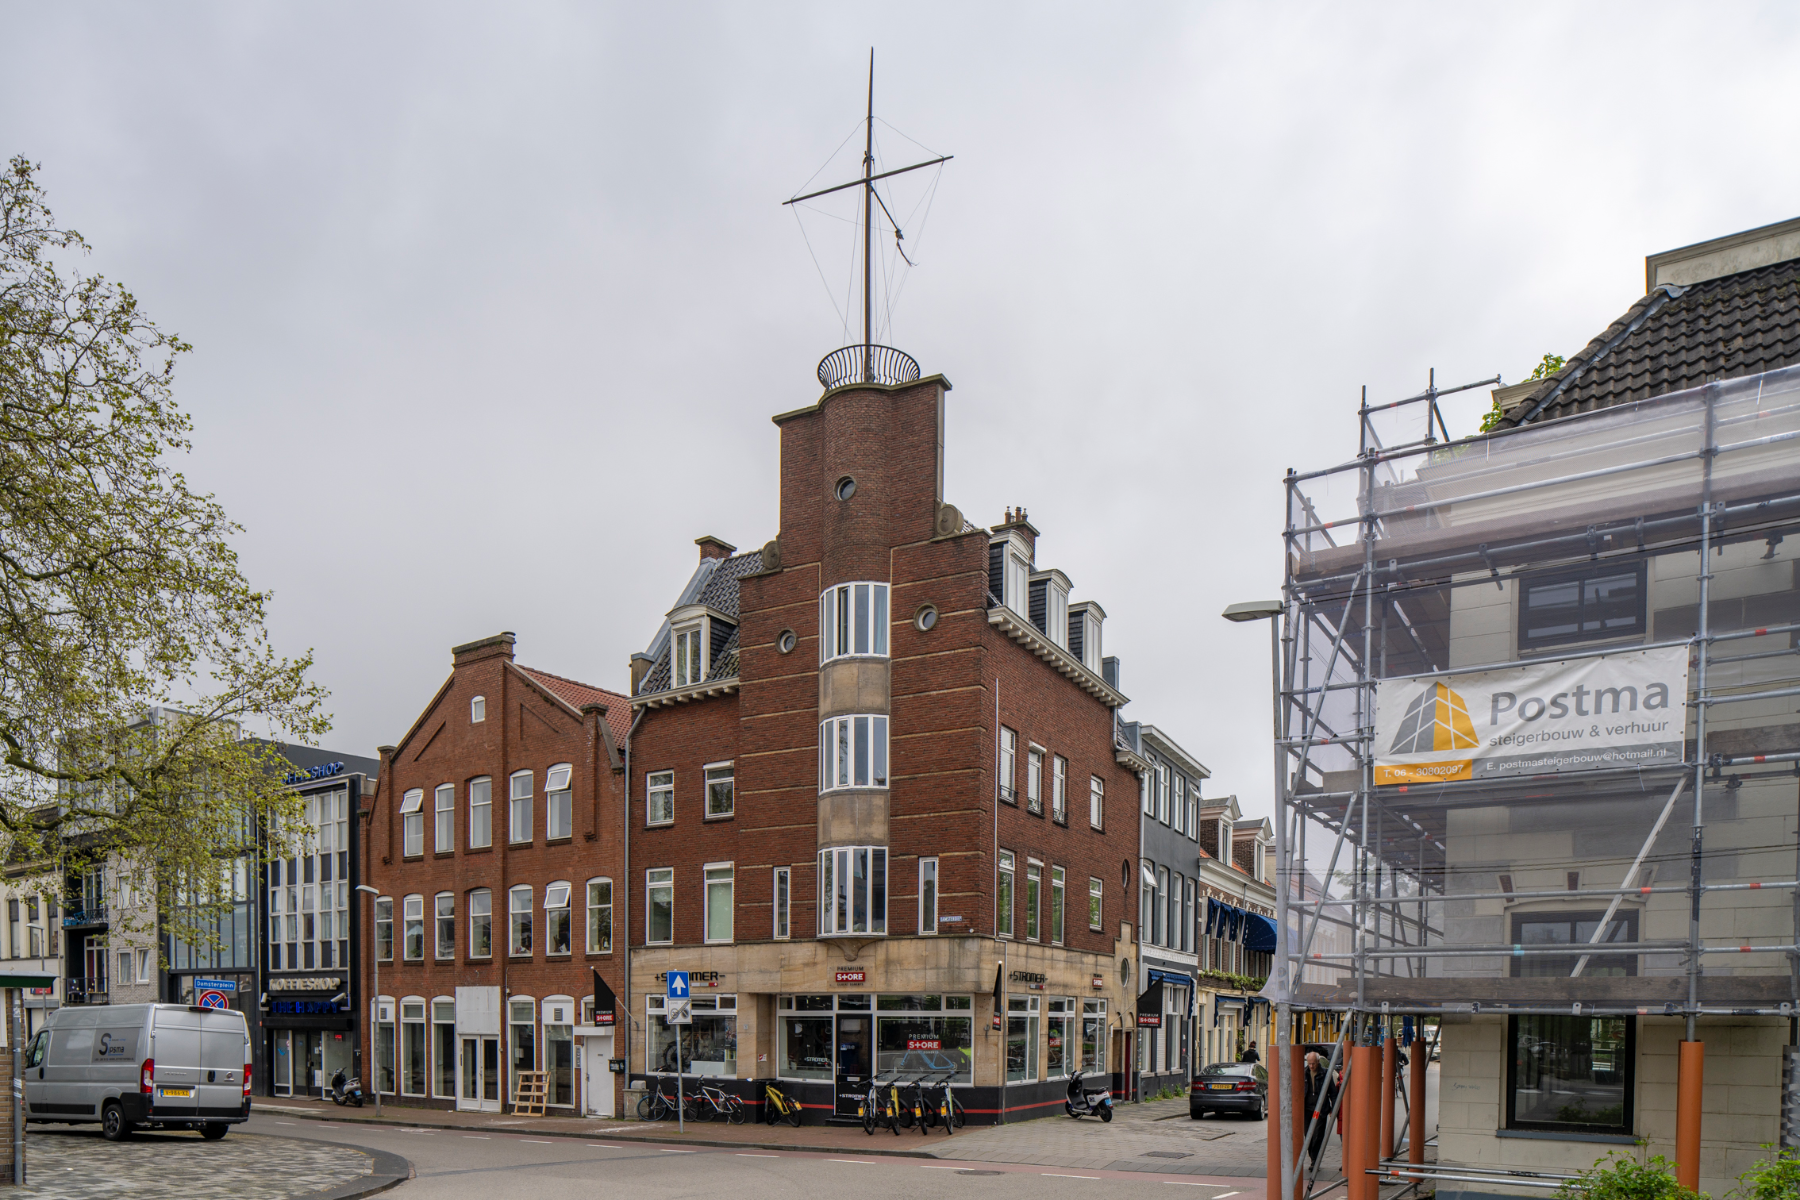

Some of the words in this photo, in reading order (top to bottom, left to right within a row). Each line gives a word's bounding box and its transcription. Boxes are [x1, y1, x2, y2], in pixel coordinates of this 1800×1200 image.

[1490, 682, 1669, 726] Postma
[1489, 728, 1585, 747] steigerbouw
[1589, 724, 1600, 738] &
[1605, 721, 1669, 736] verhuur
[1486, 761, 1497, 771] E.
[1499, 748, 1667, 771] postmasteigerbouw@hotmail.nl
[1383, 769, 1392, 778] T.
[1394, 769, 1407, 777] 06
[1416, 764, 1464, 777] 30802097
[196, 980, 234, 989] Damsterplein
[268, 977, 341, 991] KOFFIESHOP
[272, 1001, 292, 1014] THE
[295, 1001, 339, 1014] HAPPY
